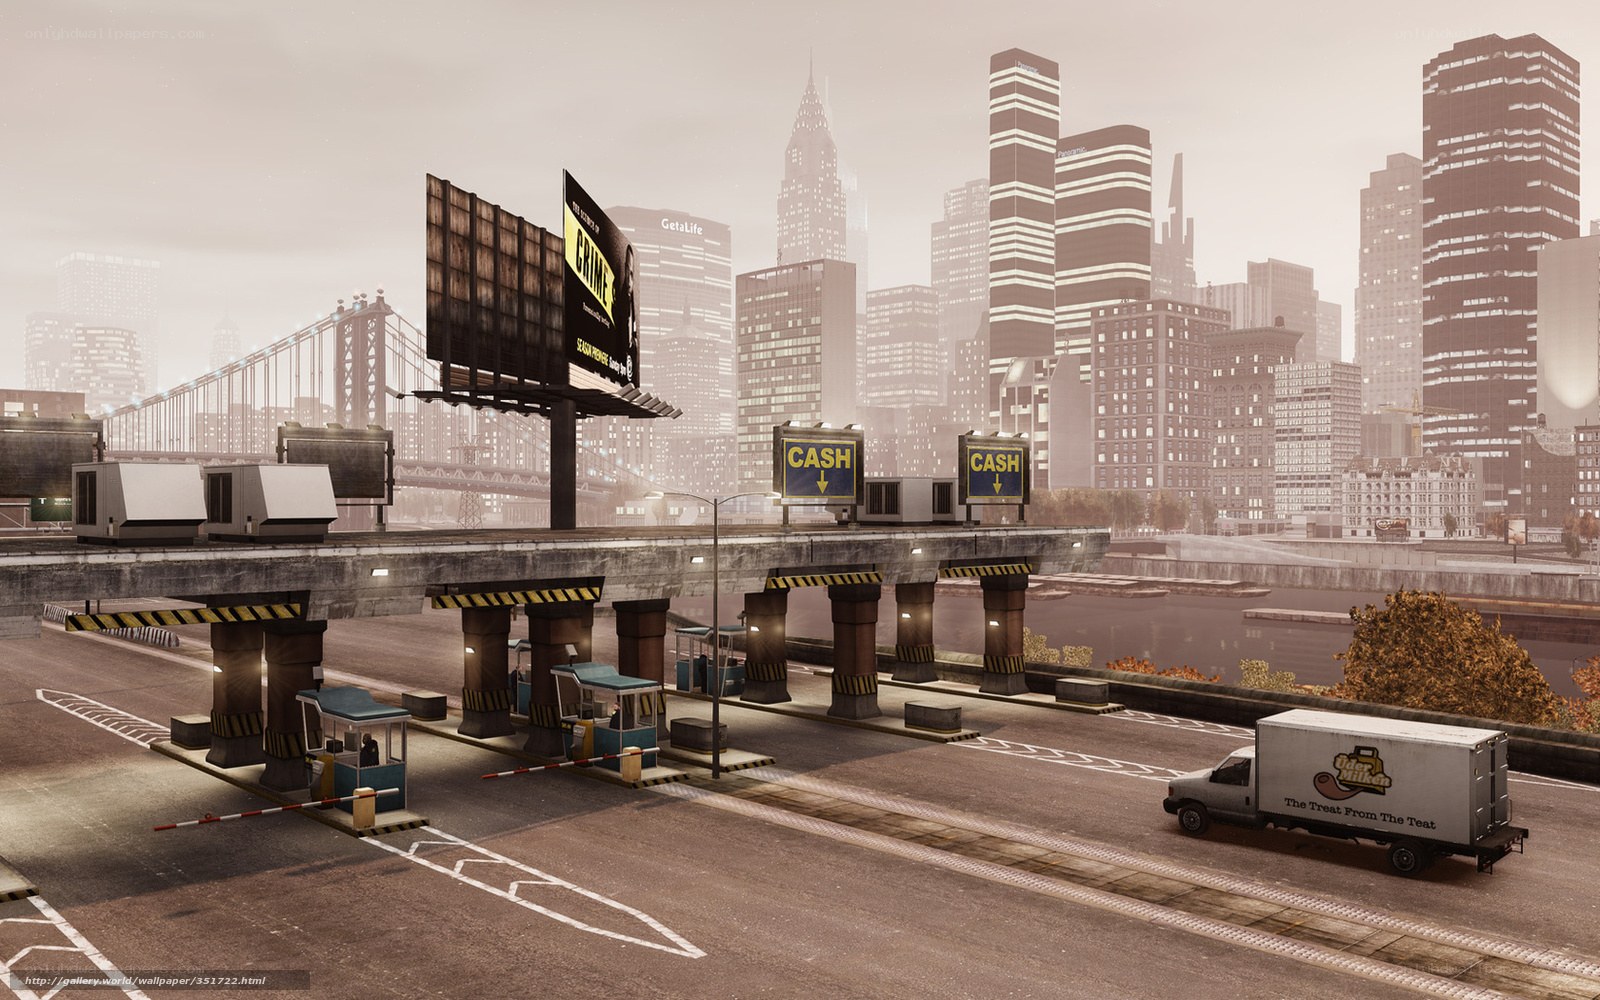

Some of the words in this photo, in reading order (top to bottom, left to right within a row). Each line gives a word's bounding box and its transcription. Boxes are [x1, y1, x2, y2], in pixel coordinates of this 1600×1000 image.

[661, 218, 703, 235] GetaLife
[576, 228, 608, 307] CRIME
[787, 446, 851, 469] CASH
[970, 452, 1019, 473] CASH
[1339, 769, 1391, 787] Milken
[1284, 797, 1307, 809] The
[1309, 801, 1342, 815] Treat
[1344, 807, 1377, 820] From
[1380, 812, 1404, 825] The
[1406, 816, 1437, 830] Teat
